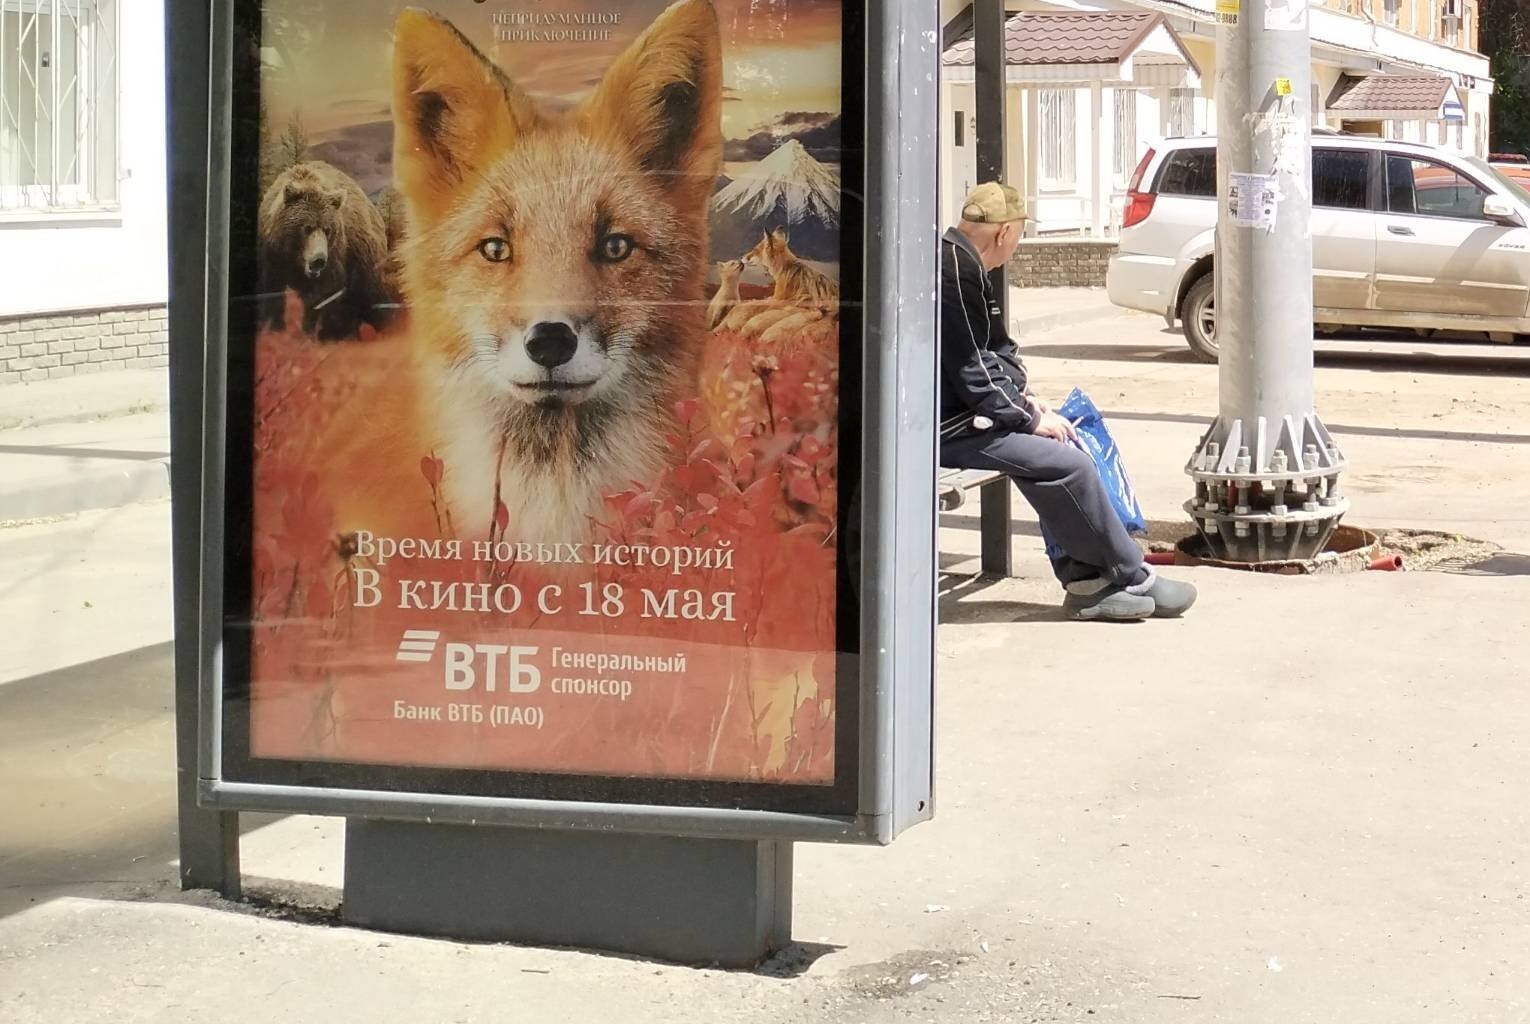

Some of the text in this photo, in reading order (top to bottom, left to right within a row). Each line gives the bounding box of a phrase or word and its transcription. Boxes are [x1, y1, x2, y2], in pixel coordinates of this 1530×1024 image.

[355, 530, 735, 574] Время новых историй
[353, 568, 737, 621] В кино с 18 мая
[445, 643, 541, 693] ВТБ
[551, 646, 687, 674] Генеральный
[550, 675, 632, 700] спонсор
[393, 700, 545, 728] Банк ВТБ (ПАО)
